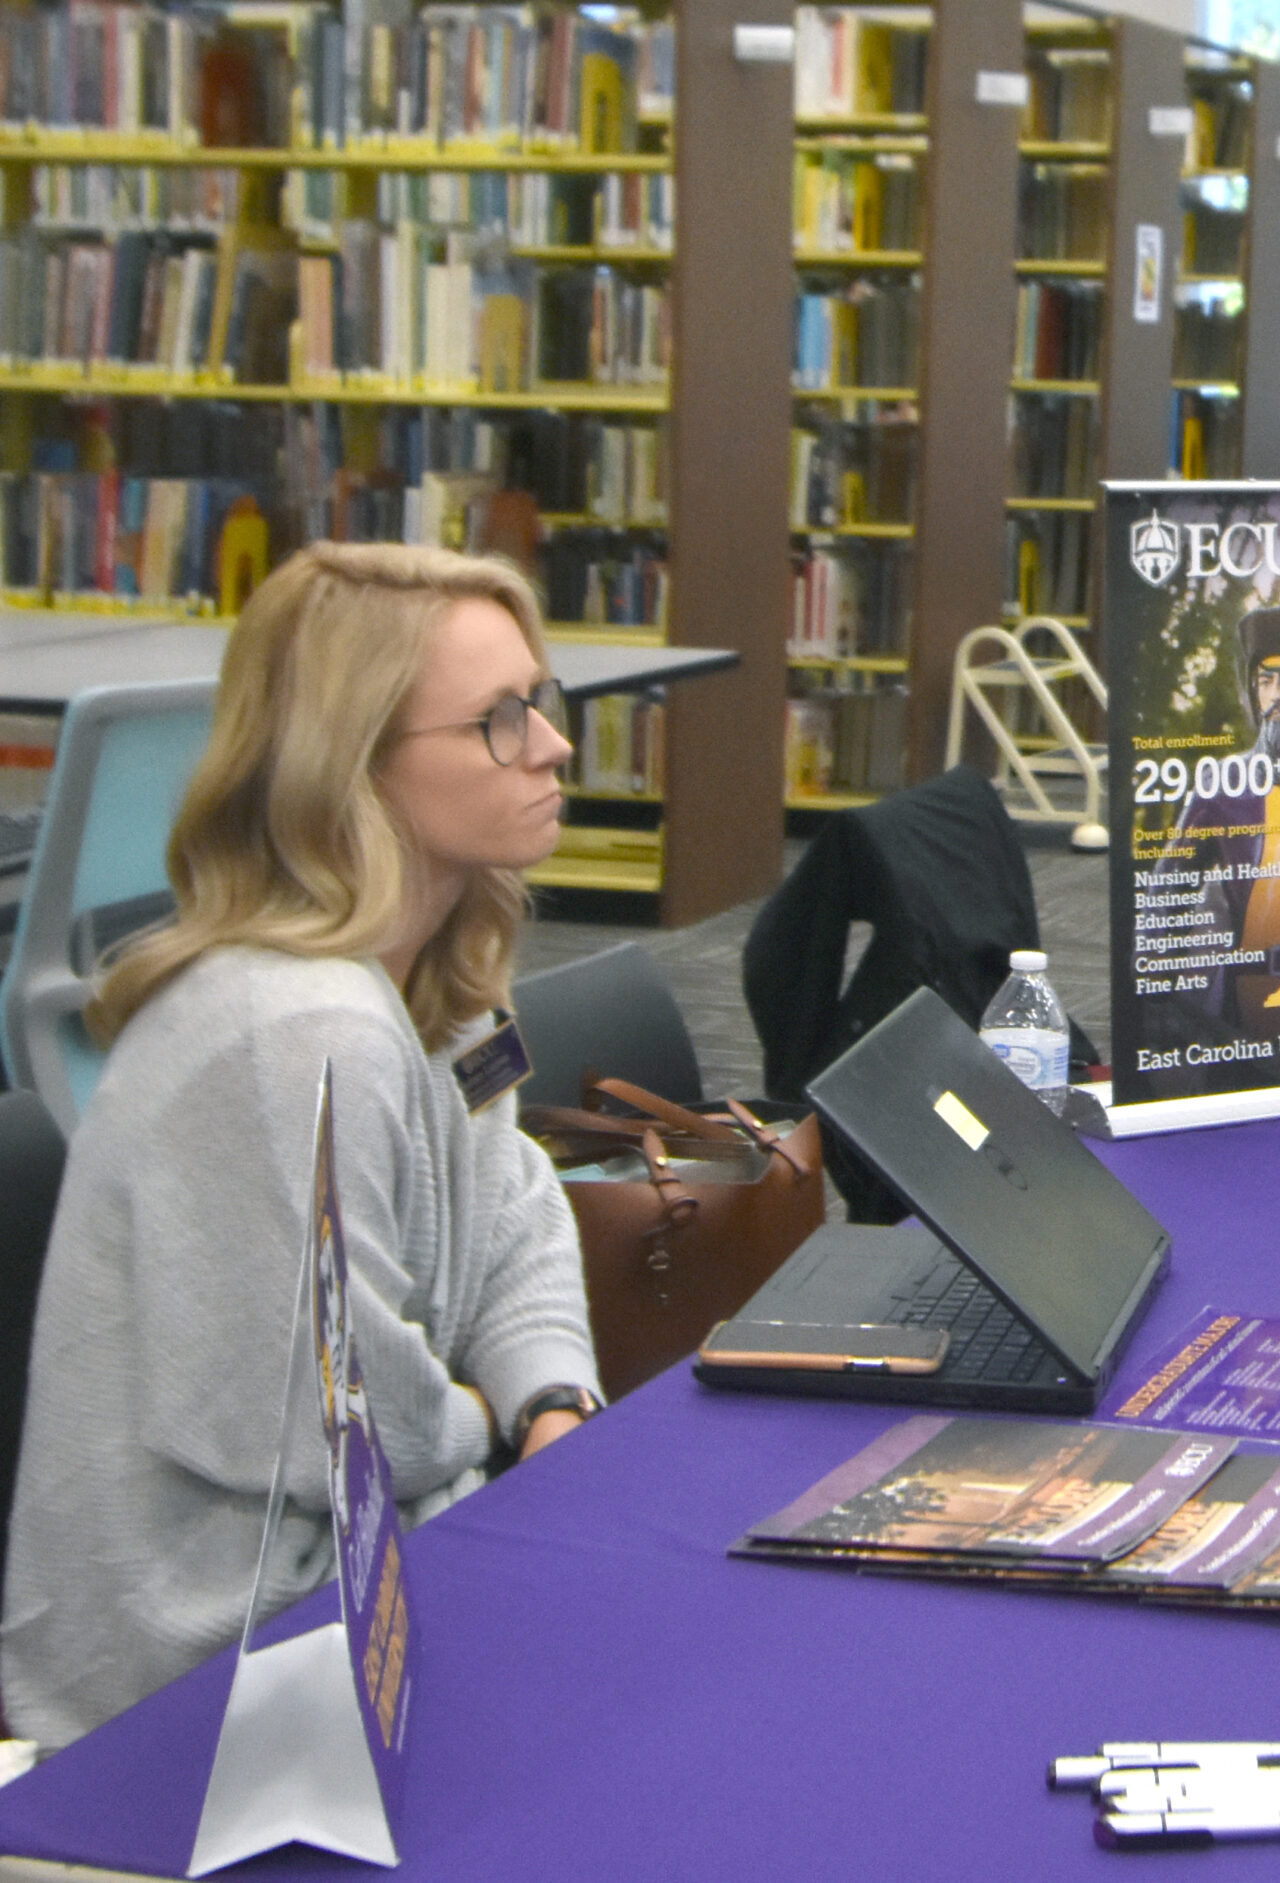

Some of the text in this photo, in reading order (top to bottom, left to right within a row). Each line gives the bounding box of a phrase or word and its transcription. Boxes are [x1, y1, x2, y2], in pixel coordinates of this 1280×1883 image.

[1132, 734, 1236, 750] Total enrollment:
[1133, 828, 1163, 842] Over
[1185, 826, 1225, 841] degree
[1134, 869, 1200, 888] Nursing
[1203, 866, 1233, 883] and
[1134, 891, 1206, 910] Business
[1134, 911, 1215, 931] Education
[1134, 930, 1235, 953] Engineering
[1135, 949, 1266, 974] Communication
[1135, 974, 1208, 995] Fine Arts
[1137, 1048, 1181, 1072] East
[1185, 1040, 1274, 1066] Carolina
